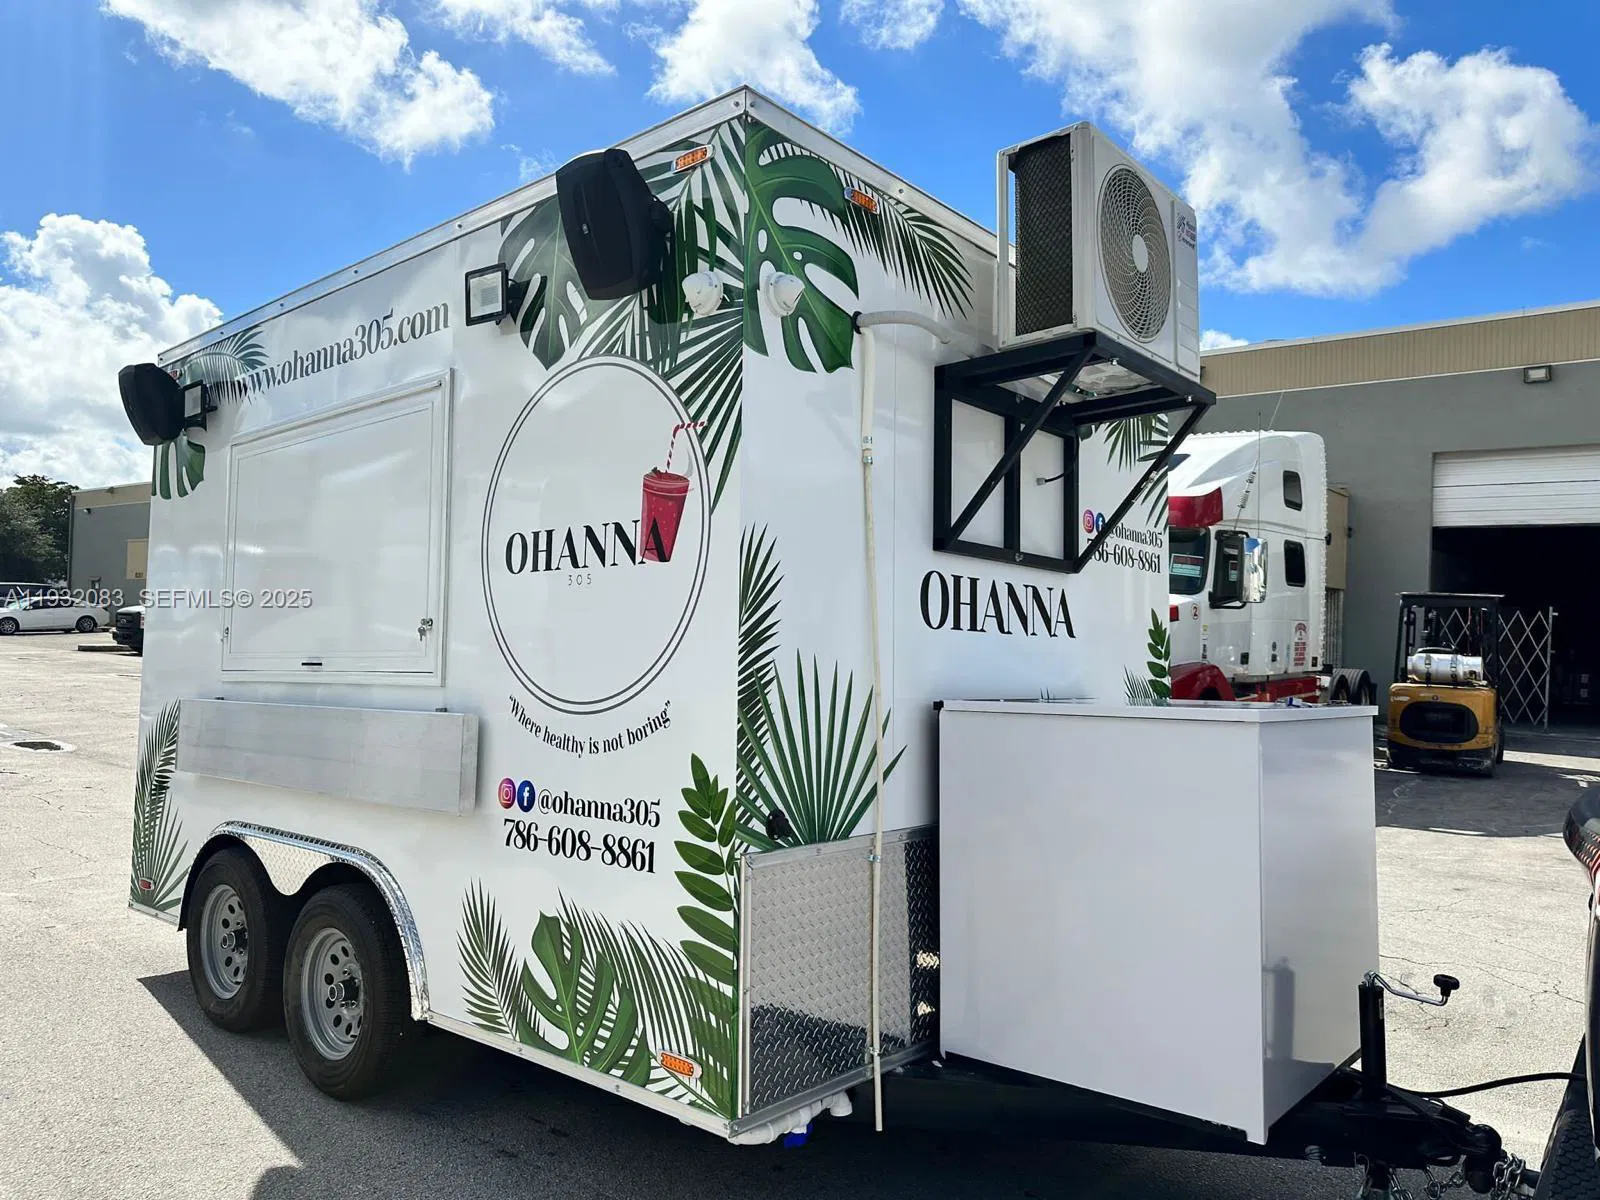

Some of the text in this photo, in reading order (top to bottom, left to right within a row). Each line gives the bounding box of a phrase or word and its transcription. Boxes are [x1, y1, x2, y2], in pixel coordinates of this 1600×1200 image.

[505, 517, 671, 575] OHANNA
[568, 573, 592, 586] 305
[920, 570, 1076, 639] OHANNA
[542, 725, 586, 758] healthy
[588, 736, 600, 754] is
[602, 732, 625, 753] not
[538, 788, 661, 828] @ohanna305
[503, 818, 656, 874] 786-608-8861
